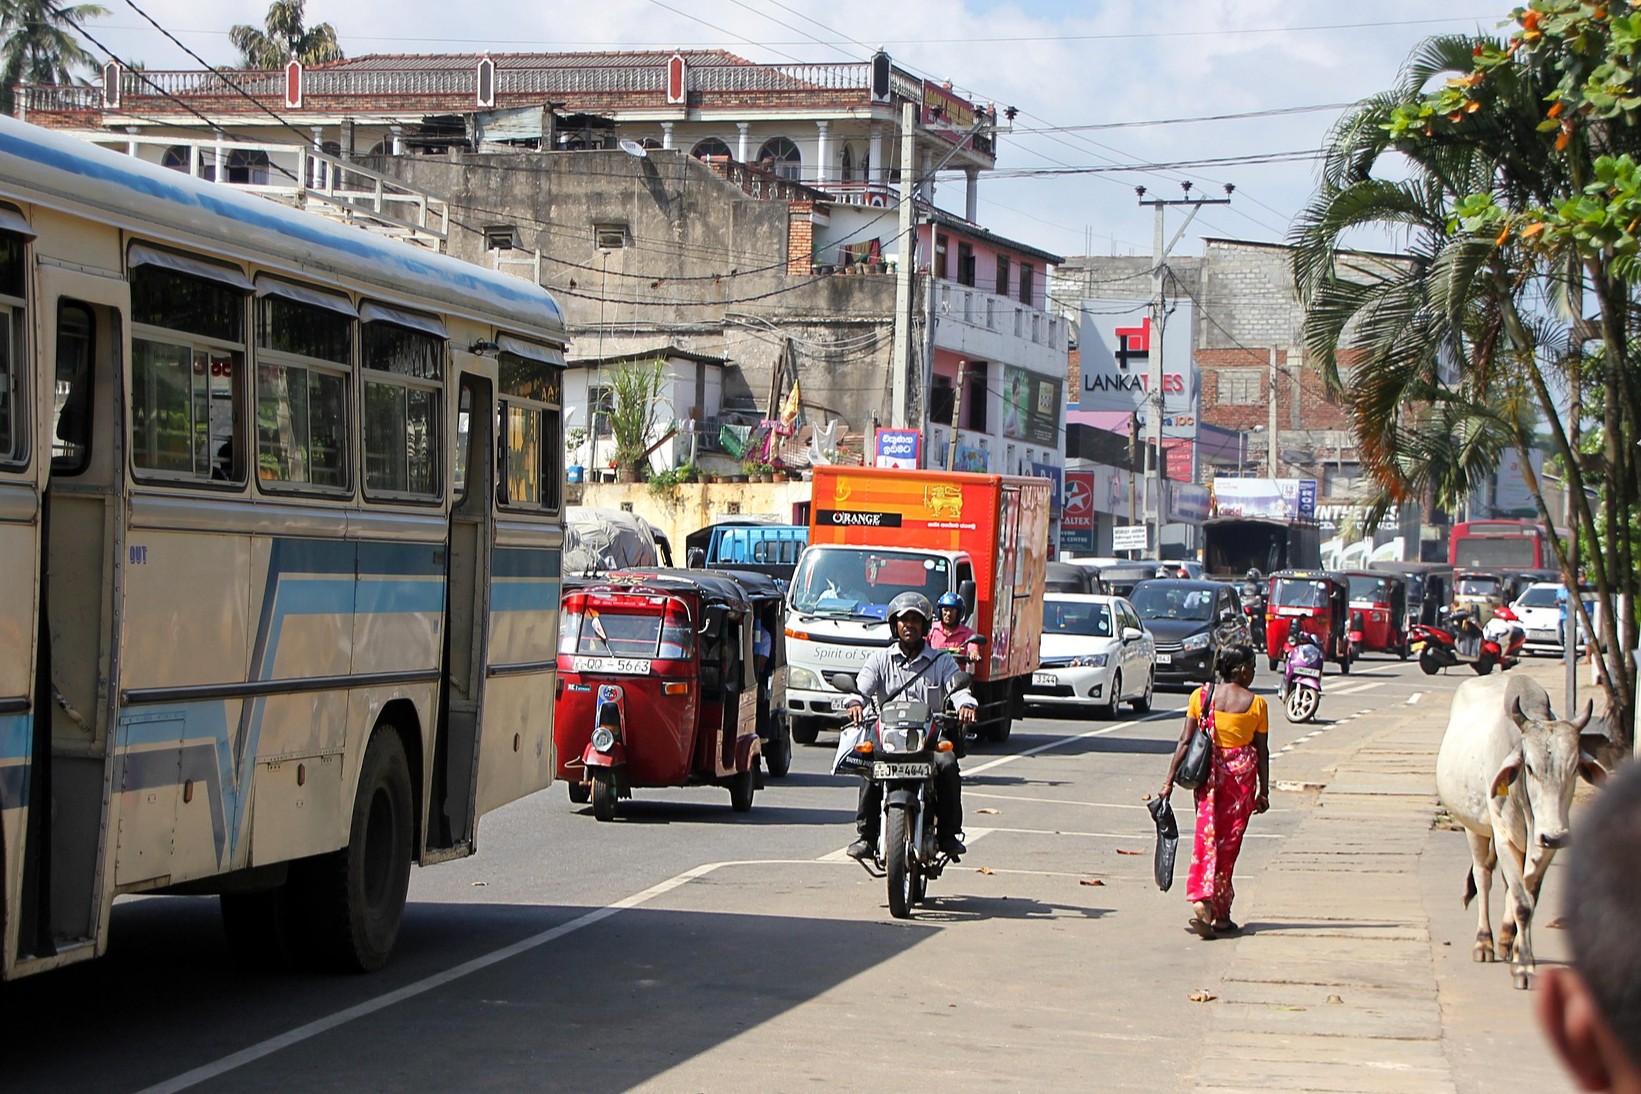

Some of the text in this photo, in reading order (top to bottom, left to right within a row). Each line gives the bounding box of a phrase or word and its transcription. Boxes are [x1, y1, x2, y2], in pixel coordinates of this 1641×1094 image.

[1085, 374, 1184, 391] LANKATES
[832, 511, 880, 523] ORANGE
[1061, 517, 1090, 525] ALTEX
[130, 546, 147, 564] OUT
[814, 647, 842, 661] Spirit
[845, 648, 858, 660] of
[617, 660, 649, 673] 5663
